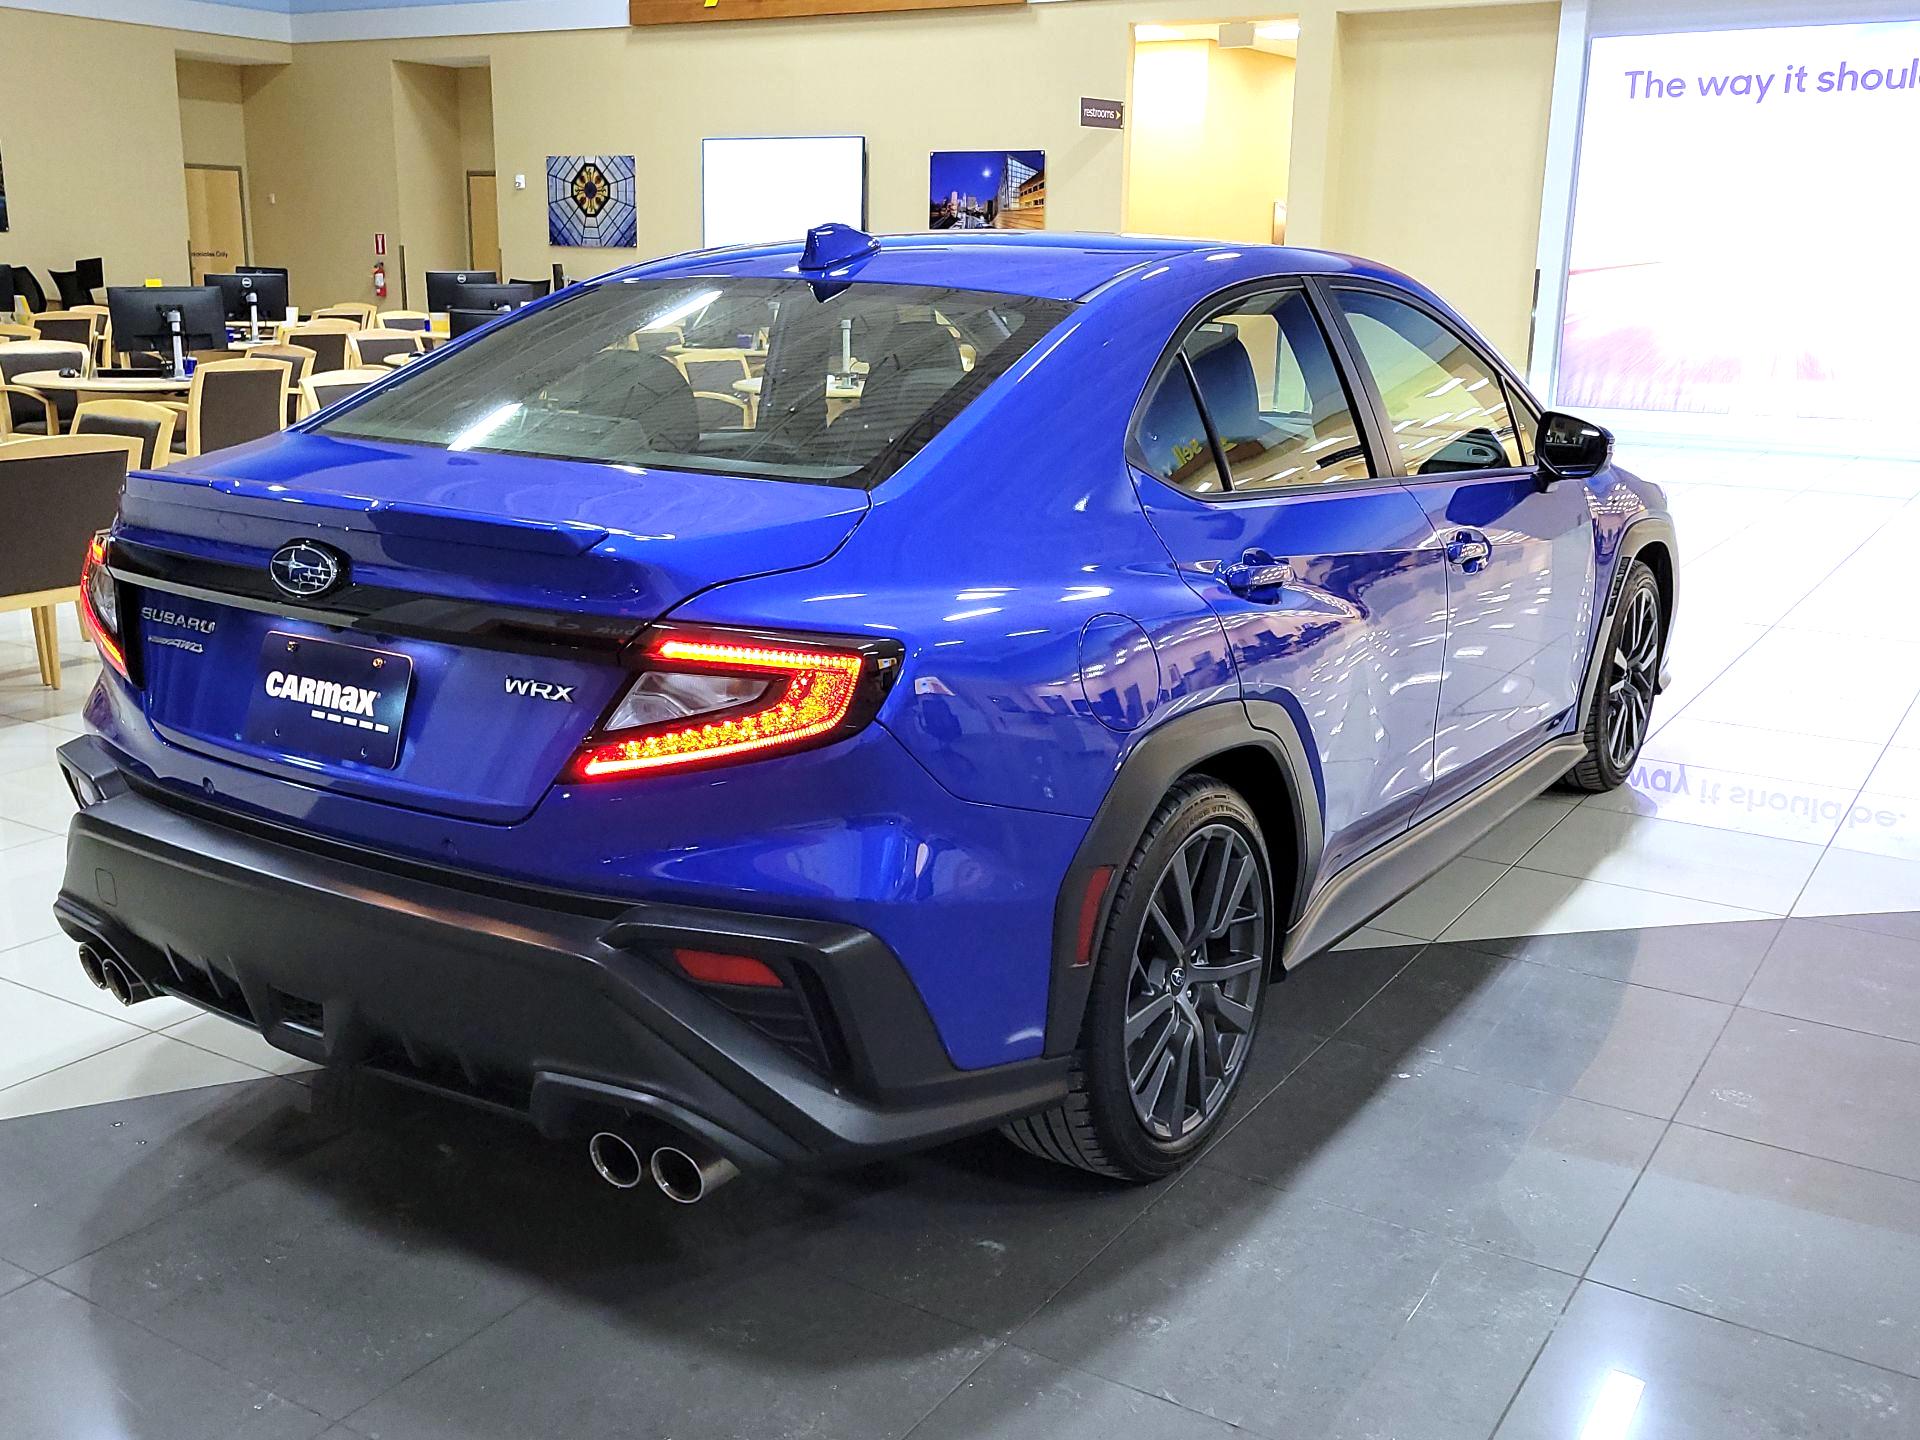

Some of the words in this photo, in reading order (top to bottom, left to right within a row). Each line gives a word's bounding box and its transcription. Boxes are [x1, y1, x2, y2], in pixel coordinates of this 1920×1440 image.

[1624, 70, 1687, 99] The
[1697, 74, 1775, 104] way
[1784, 64, 1808, 93] it
[1816, 57, 1920, 93] shoul
[1083, 107, 1115, 119] restrooms
[141, 606, 216, 634] SUBARU
[505, 678, 576, 704] WRX
